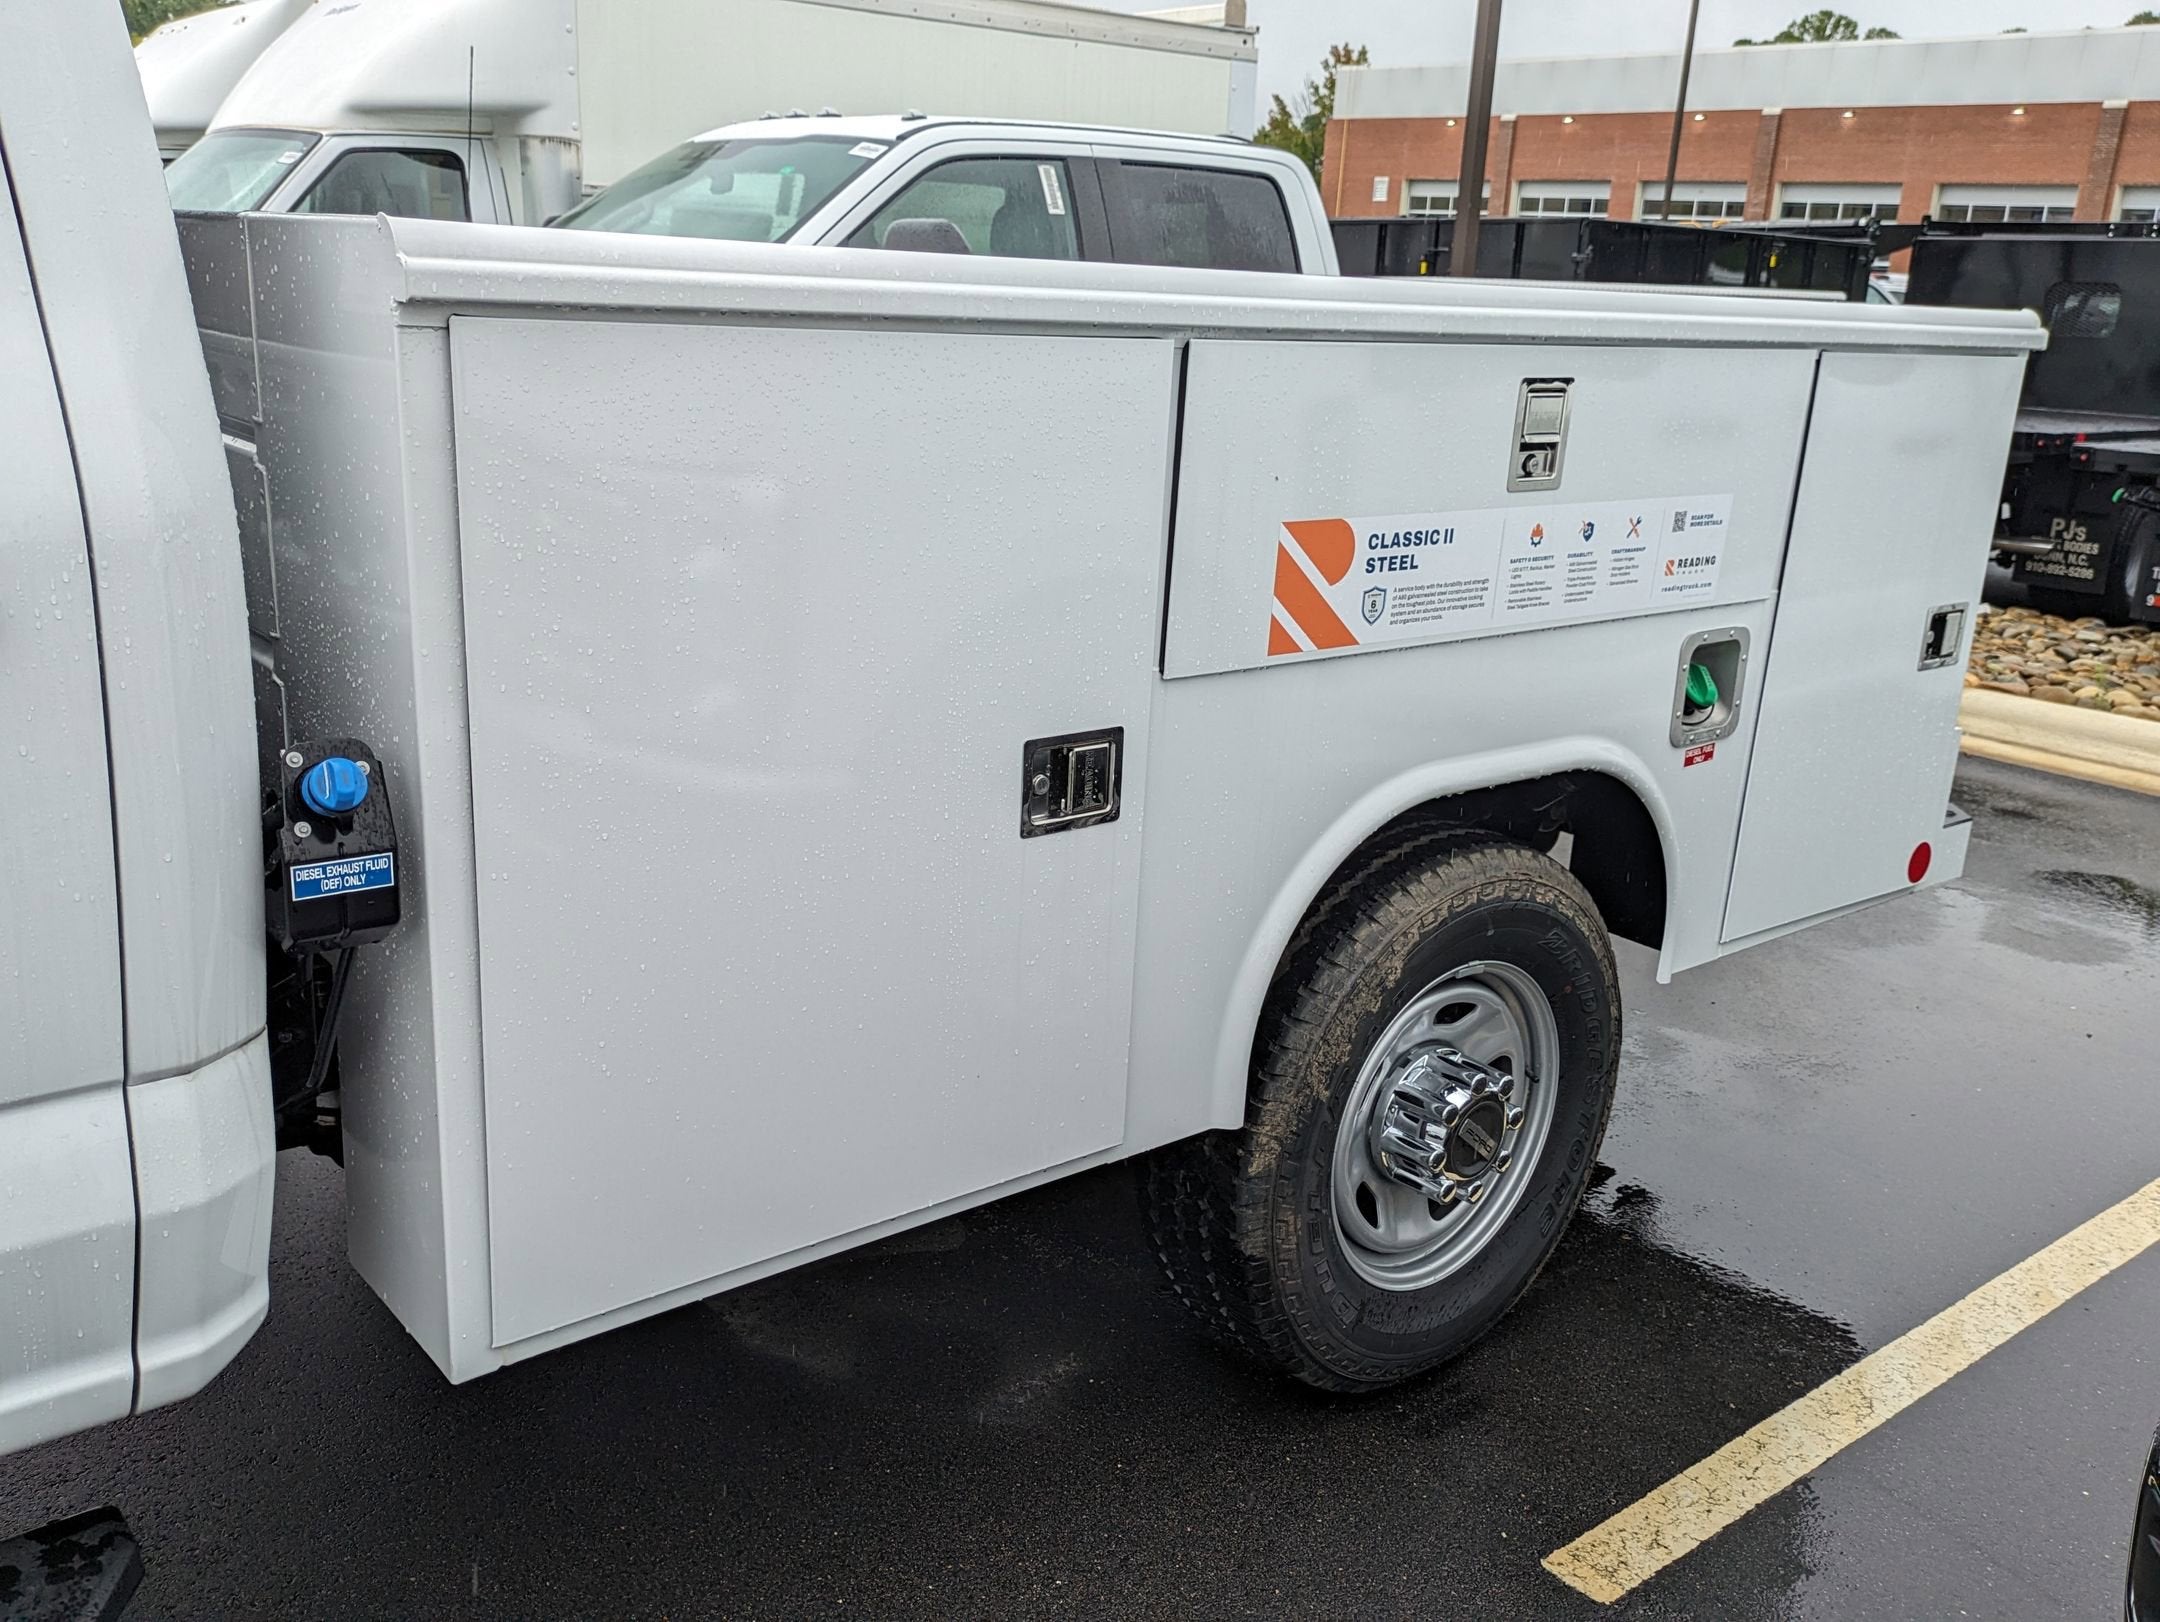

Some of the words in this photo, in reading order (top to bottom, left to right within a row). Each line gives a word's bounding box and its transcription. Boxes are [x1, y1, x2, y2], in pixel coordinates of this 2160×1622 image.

[1368, 530, 1440, 550] CLASSIC
[1444, 528, 1454, 544] II
[1366, 554, 1418, 574] STEEL
[1678, 555, 1716, 568] READING
[1661, 582, 1712, 592] readingtruck.com
[1371, 600, 1376, 609] 6
[296, 867, 325, 882] DIESEL
[327, 862, 364, 877] EXHAUST
[366, 858, 389, 871] FLUID
[321, 876, 342, 892] (DEF)
[344, 874, 366, 886] ONLY
